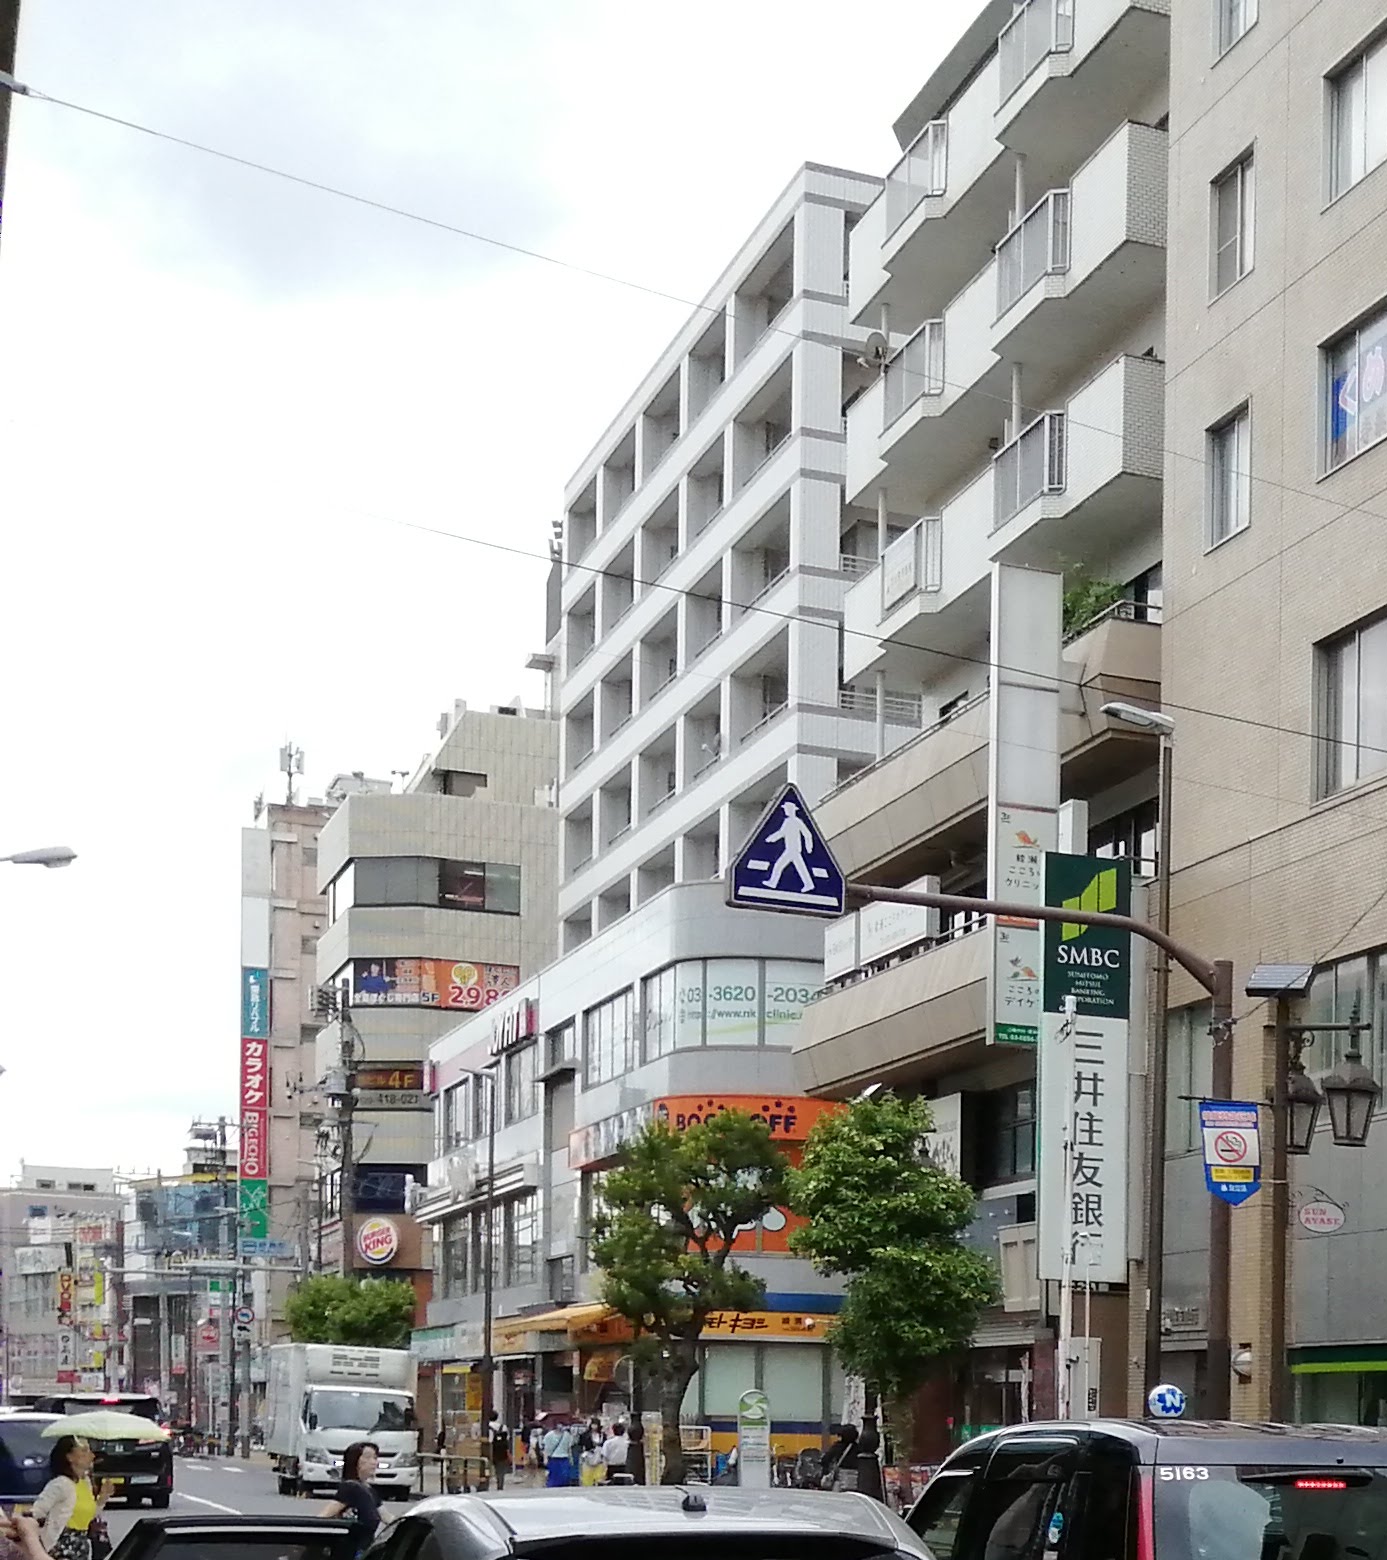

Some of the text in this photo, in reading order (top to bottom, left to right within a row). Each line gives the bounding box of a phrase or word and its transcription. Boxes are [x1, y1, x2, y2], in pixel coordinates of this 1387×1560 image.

[1057, 944, 1120, 968] SMBC
[244, 1041, 263, 1105] カラオケ
[388, 1071, 414, 1089] 4F
[1304, 1208, 1327, 1216] SUN
[1304, 1217, 1341, 1226] AYASE
[363, 1226, 391, 1242] BURGER
[364, 1234, 393, 1253] KING
[1160, 1466, 1210, 1481] 5163
